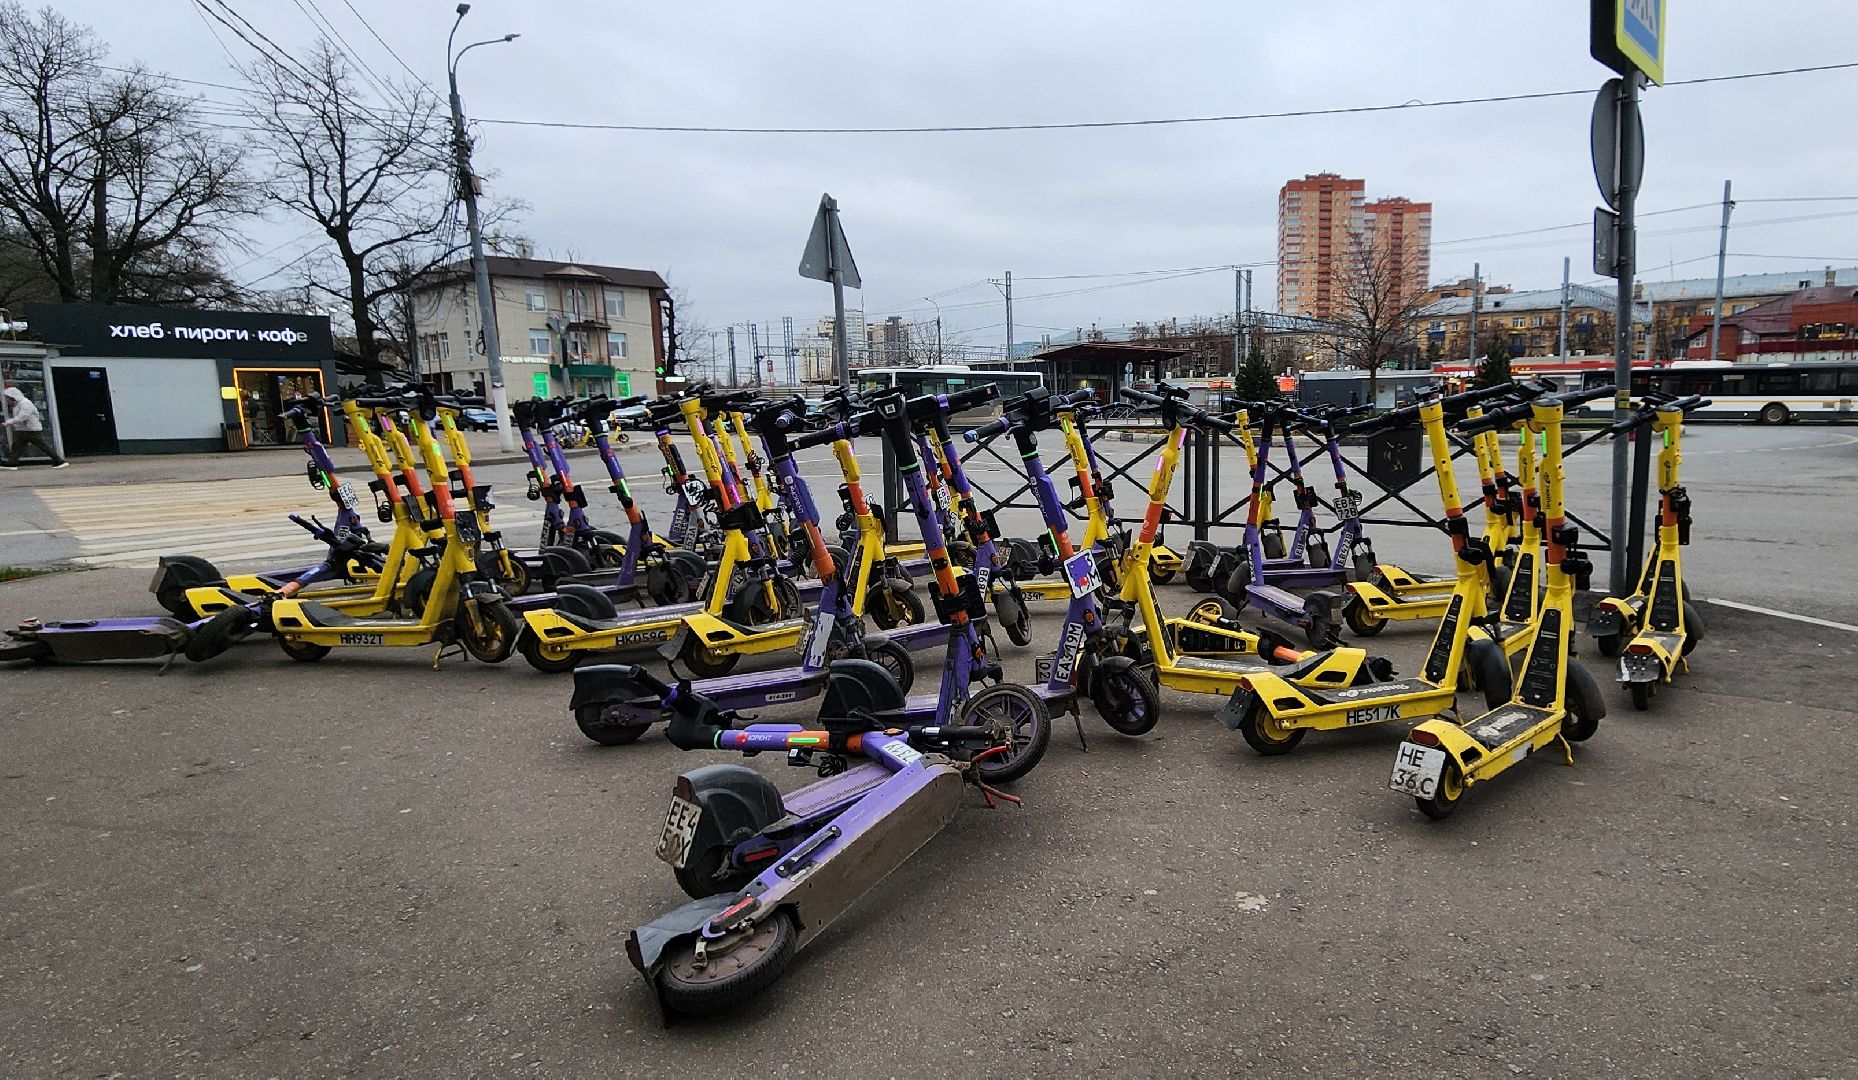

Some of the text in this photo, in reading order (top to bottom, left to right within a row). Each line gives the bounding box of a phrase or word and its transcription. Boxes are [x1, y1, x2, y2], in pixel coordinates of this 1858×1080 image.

[109, 322, 308, 345] хлеб пироги кофе
